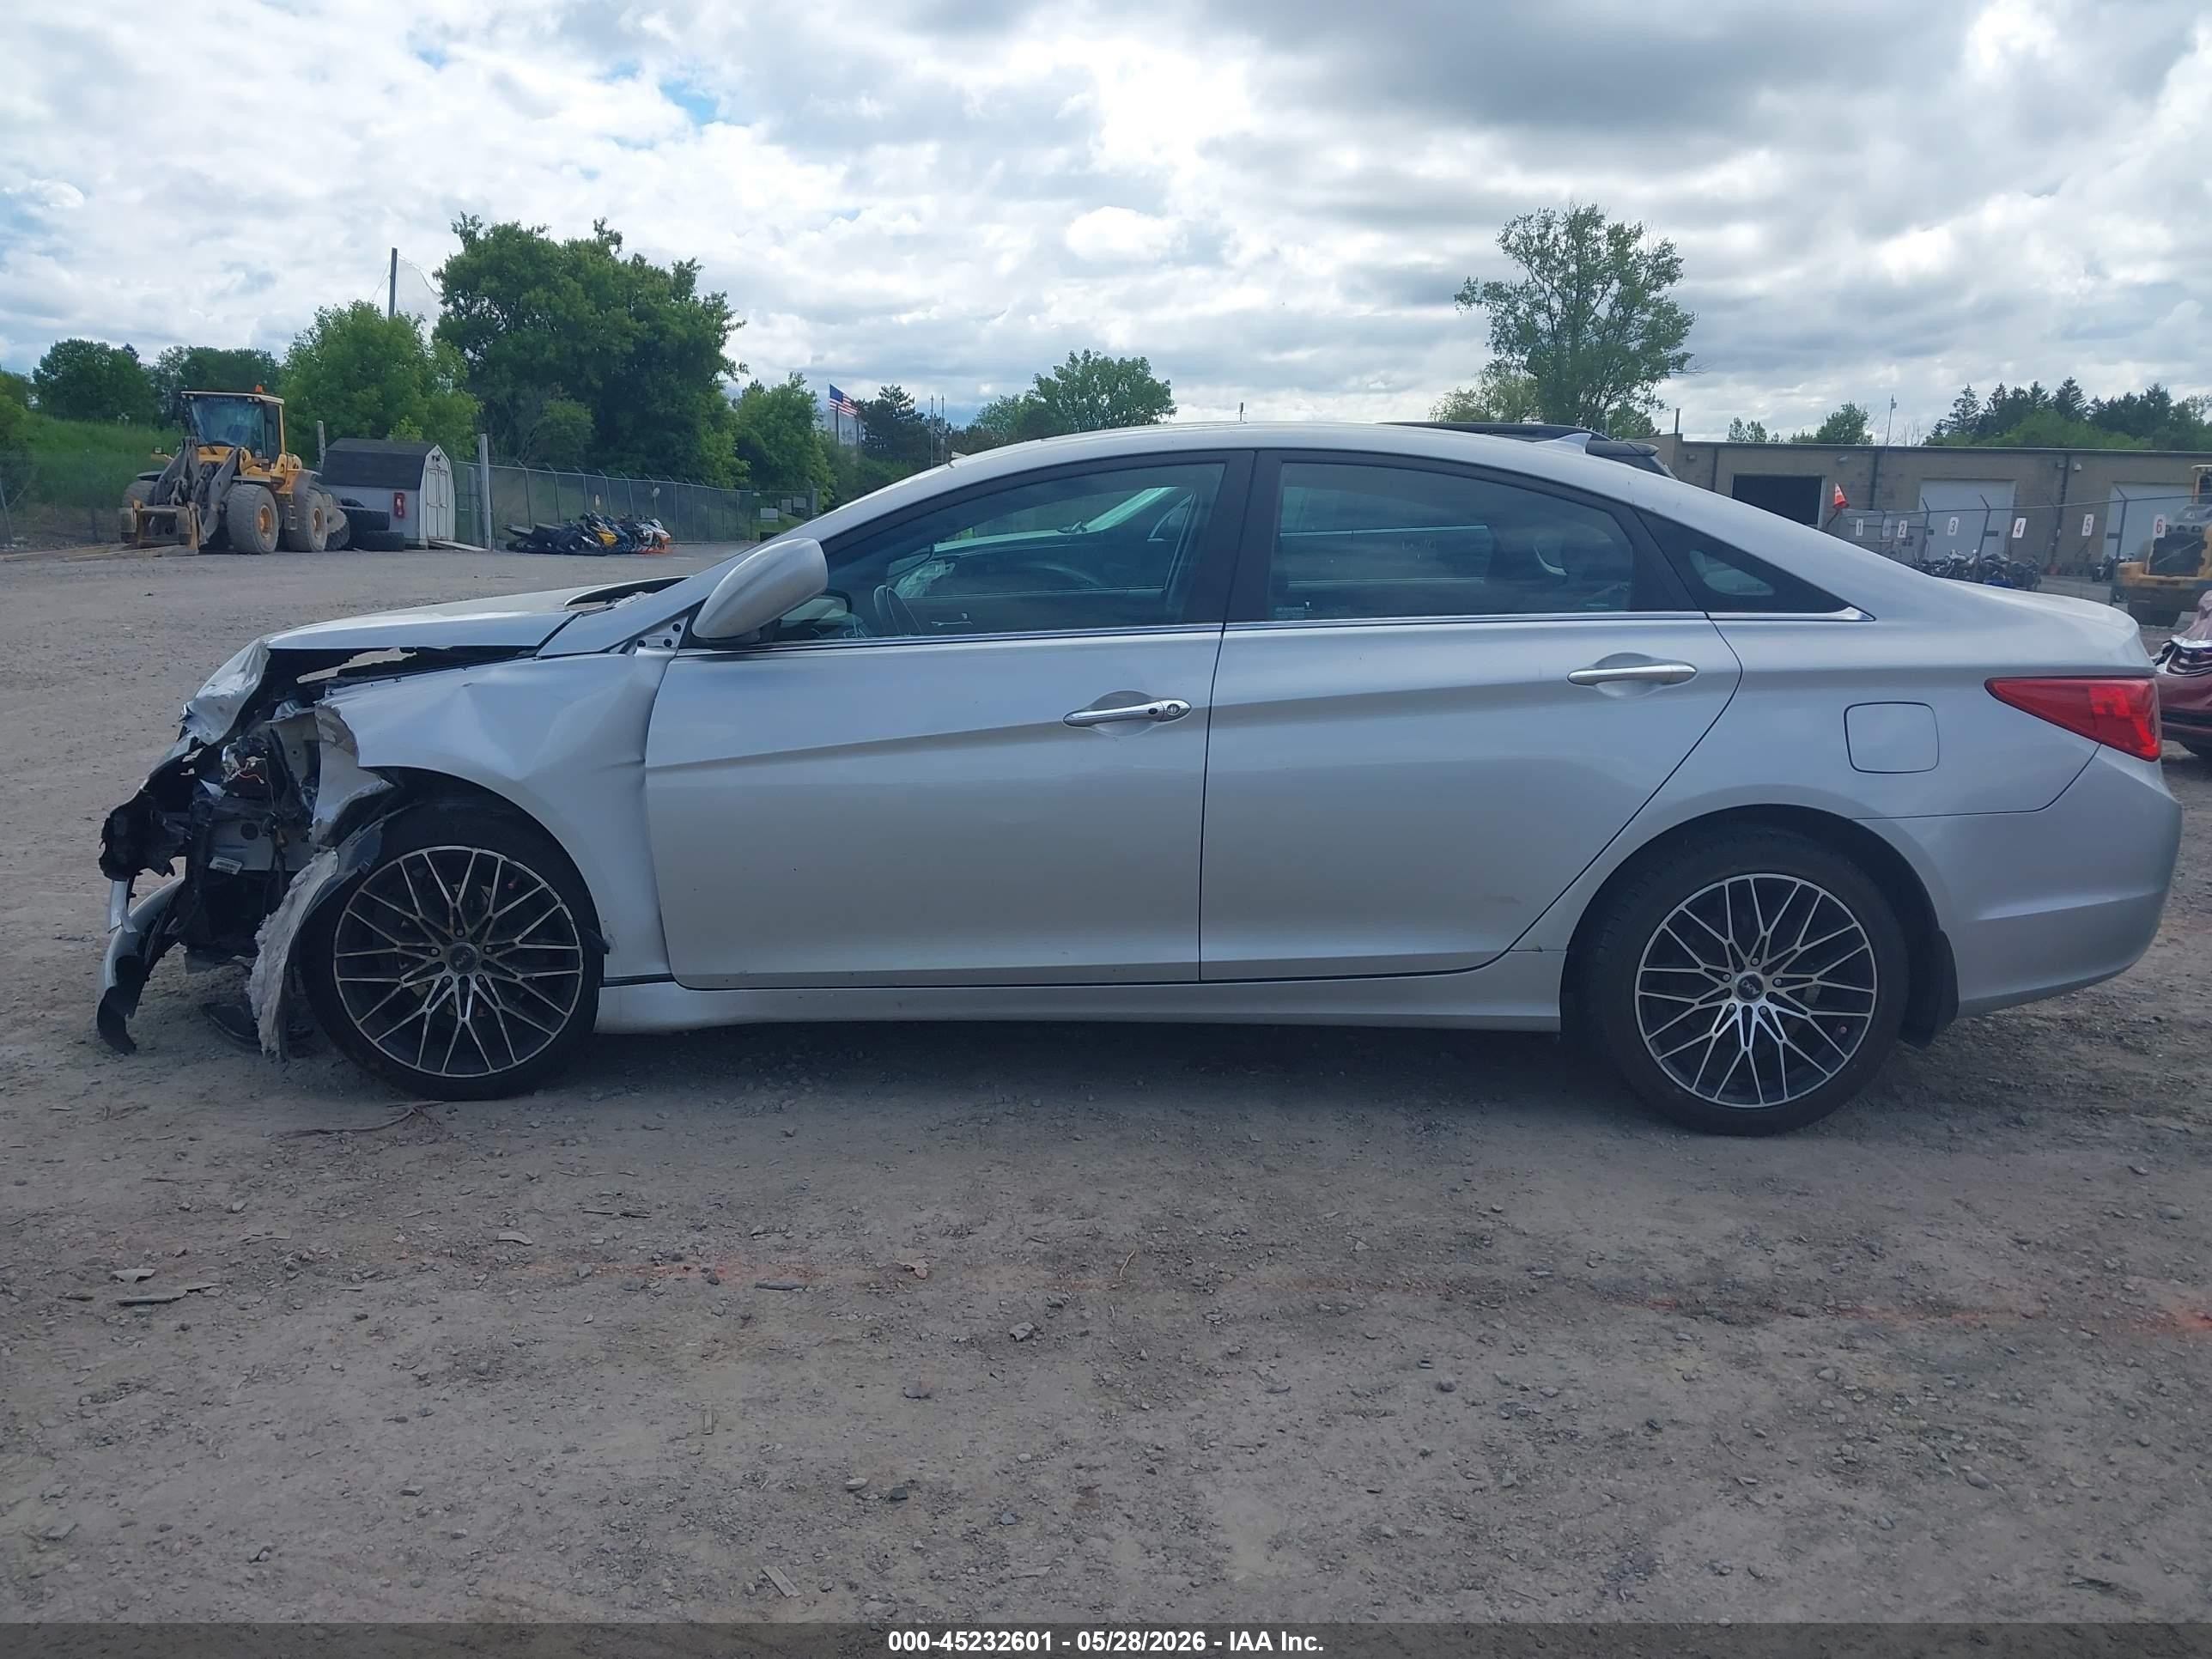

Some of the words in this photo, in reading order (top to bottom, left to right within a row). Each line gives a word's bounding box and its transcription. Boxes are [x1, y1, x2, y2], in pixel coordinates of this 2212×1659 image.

[1899, 523, 1905, 535] 2
[1950, 520, 1956, 532] 3
[2015, 521, 2022, 535] 4
[2085, 517, 2091, 532] 5
[2155, 519, 2163, 533] 6
